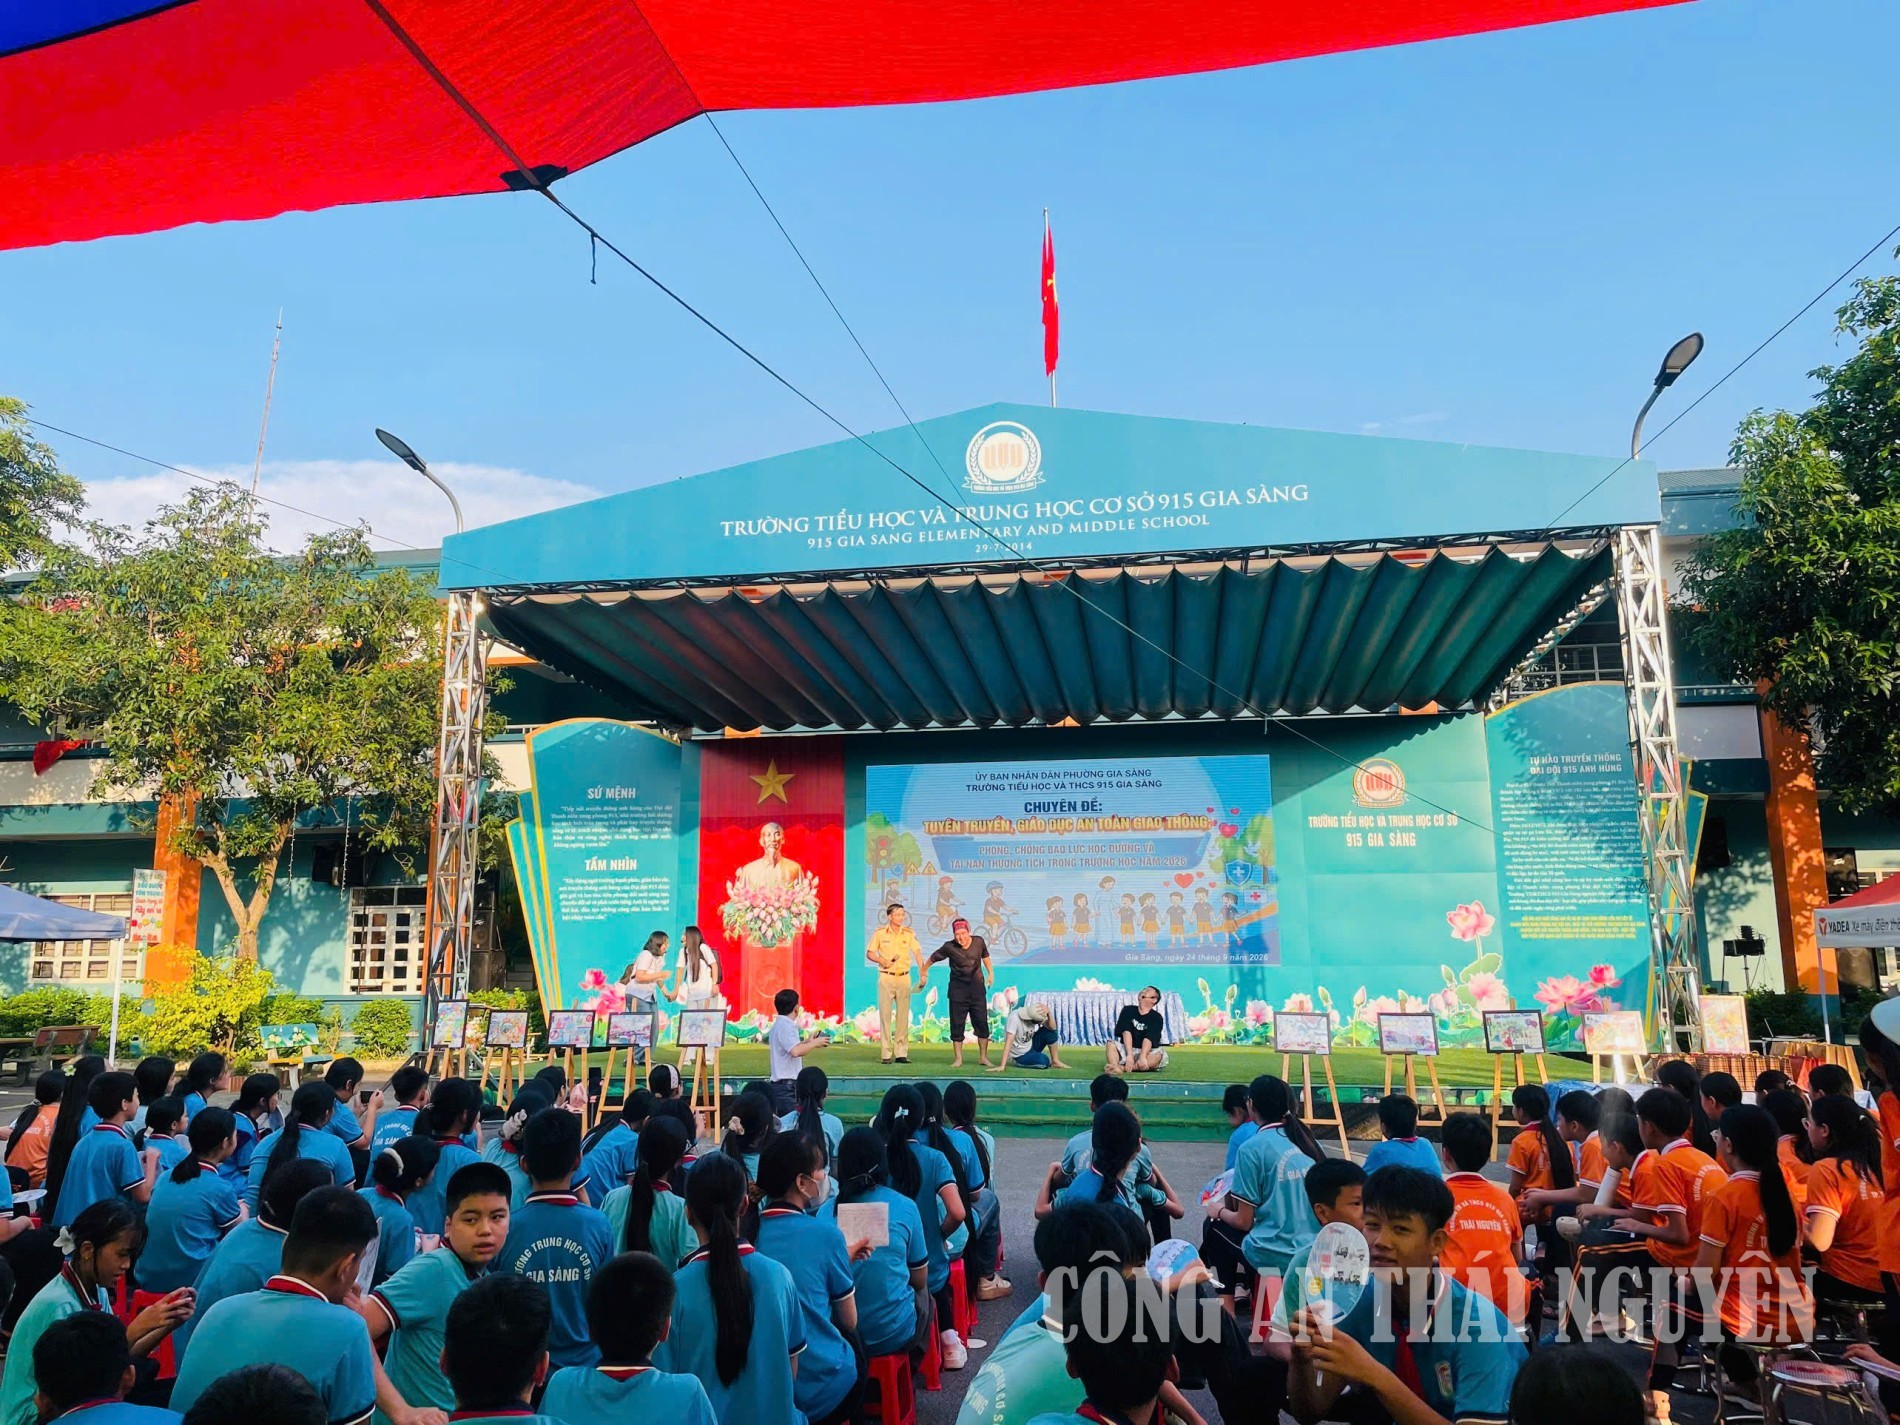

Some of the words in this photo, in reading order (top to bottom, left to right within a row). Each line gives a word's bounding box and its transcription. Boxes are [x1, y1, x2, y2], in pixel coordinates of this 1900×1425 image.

[721, 515, 809, 536] TRƯỜNG
[814, 508, 862, 531] TIỂU
[868, 510, 915, 530] HỌC
[919, 506, 947, 525] VÀ
[953, 503, 1029, 523] TRUNG
[1035, 499, 1083, 518] HỌC
[1089, 496, 1122, 515] CƠ
[1126, 490, 1156, 513] SỞ
[1157, 492, 1193, 511] 915
[1199, 489, 1240, 507] GIA
[1246, 484, 1309, 505] SÀNG
[807, 537, 832, 549] 915
[837, 535, 865, 548] GIA
[871, 532, 913, 545] SANG
[918, 525, 1022, 543] ELEMENTARY
[1027, 522, 1063, 536] AND
[1069, 518, 1136, 533] MIDDLE
[1141, 514, 1210, 529] SCHOOL
[989, 772, 1009, 781] BAN
[1011, 770, 1039, 781] NHÂN
[1041, 769, 1063, 780] DÂN
[1064, 769, 1104, 779] PHƯỜNG
[1106, 769, 1123, 778] GIA
[1125, 768, 1152, 777] SÀNG
[1562, 765, 1578, 774] 915
[1580, 765, 1597, 774] ANH
[606, 784, 636, 801] MỆNH
[966, 781, 1006, 792] TRƯỜNG
[1008, 779, 1029, 791] TIỂU
[1031, 781, 1051, 792] HỌC
[1053, 779, 1067, 790] VÀ
[1069, 780, 1095, 790] THCS
[1097, 780, 1114, 789] 915
[1115, 779, 1133, 788] GIA
[1135, 777, 1163, 788] SÀNG
[1024, 798, 1077, 814] CHUYÊN
[923, 817, 962, 835] TUYÊN
[1016, 815, 1047, 833] GIÁO
[1048, 817, 1074, 835] DỤC
[1075, 817, 1095, 832] AN
[1096, 813, 1131, 832] TOÀN
[1131, 815, 1164, 831] GIAO
[1308, 813, 1339, 828] TRƯỜNG
[1340, 810, 1357, 828] TIỂU
[1359, 815, 1375, 830] HỌC
[1376, 813, 1387, 827] VÀ
[1388, 815, 1414, 827] TRUNG
[1416, 815, 1431, 830] HỌC
[1433, 814, 1444, 827] CƠ
[1346, 832, 1363, 847] 915
[1368, 832, 1384, 847] GIA
[1389, 830, 1417, 847] SÀNG
[610, 855, 637, 871] NHÌN
[1047, 858, 1077, 868] TRONG
[1163, 856, 1187, 866] 2026
[1828, 920, 1850, 933] YADEA
[1852, 920, 1860, 932] Xe
[1125, 953, 1139, 961] Gia
[1186, 953, 1196, 961] 24
[1249, 953, 1269, 961] 2026
[1459, 1218, 1475, 1230] THÁI
[531, 1236, 562, 1253] TRUNG
[564, 1238, 583, 1255] HỌC
[526, 1269, 545, 1283] GIA
[549, 1266, 580, 1282] SÀNG
